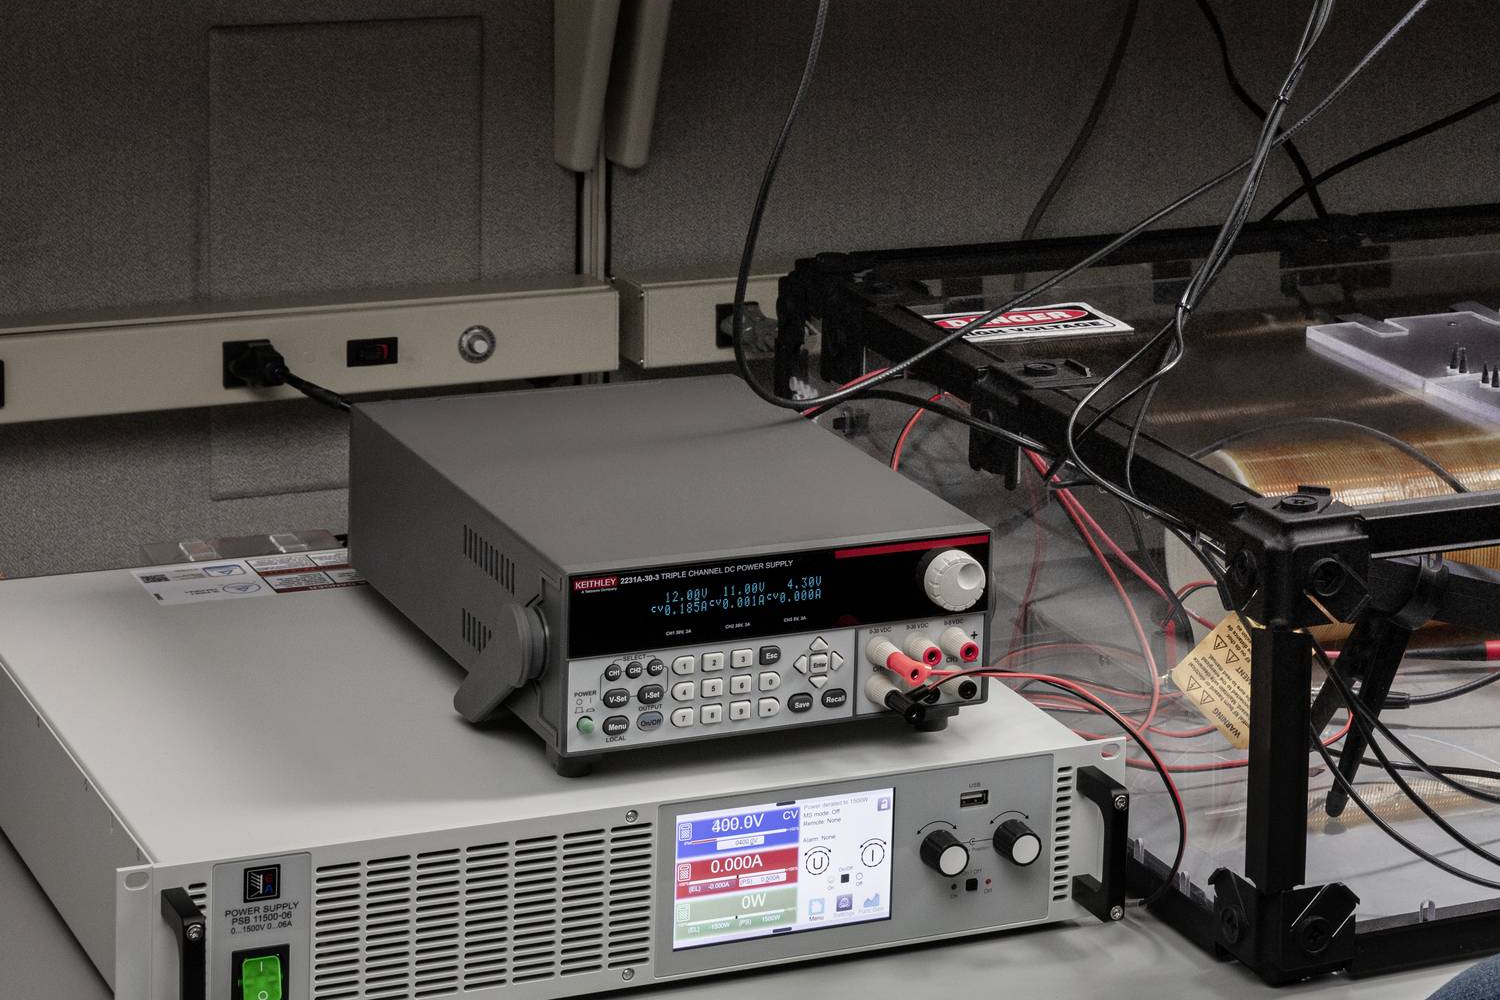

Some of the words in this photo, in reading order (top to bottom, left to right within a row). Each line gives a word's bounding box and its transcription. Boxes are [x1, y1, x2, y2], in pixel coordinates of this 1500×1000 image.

[945, 309, 1073, 329] DNGER
[965, 328, 1007, 337] IGH
[1009, 320, 1104, 333] VOLTAGE
[620, 574, 660, 585] 2231A-30-3
[661, 570, 686, 580] TRIPLE
[688, 567, 723, 577] CHANNEL
[724, 565, 735, 573] DC
[737, 562, 764, 572] POWER
[765, 560, 794, 569] SUPPLY
[575, 578, 616, 590] KEITHLEY
[787, 576, 822, 589] 4.30V
[665, 587, 708, 603] 12.00V
[723, 582, 765, 596] 11.00V
[766, 652, 778, 660] Esc
[813, 661, 827, 669] Enter
[608, 669, 620, 677] CH1
[574, 690, 597, 698] POWER
[609, 694, 627, 703] V-Set
[826, 694, 846, 704] Recall
[795, 701, 810, 709] Save
[608, 722, 627, 731] Menu
[641, 718, 662, 727] On/Off
[1212, 707, 1242, 739] WARNING
[783, 810, 798, 820] CV
[710, 855, 763, 873] 0.000A
[741, 894, 766, 909] 0W
[225, 906, 260, 918] POWER
[263, 901, 299, 913] SUPPLY
[232, 916, 250, 926] PSB
[254, 911, 292, 923] 11500-06
